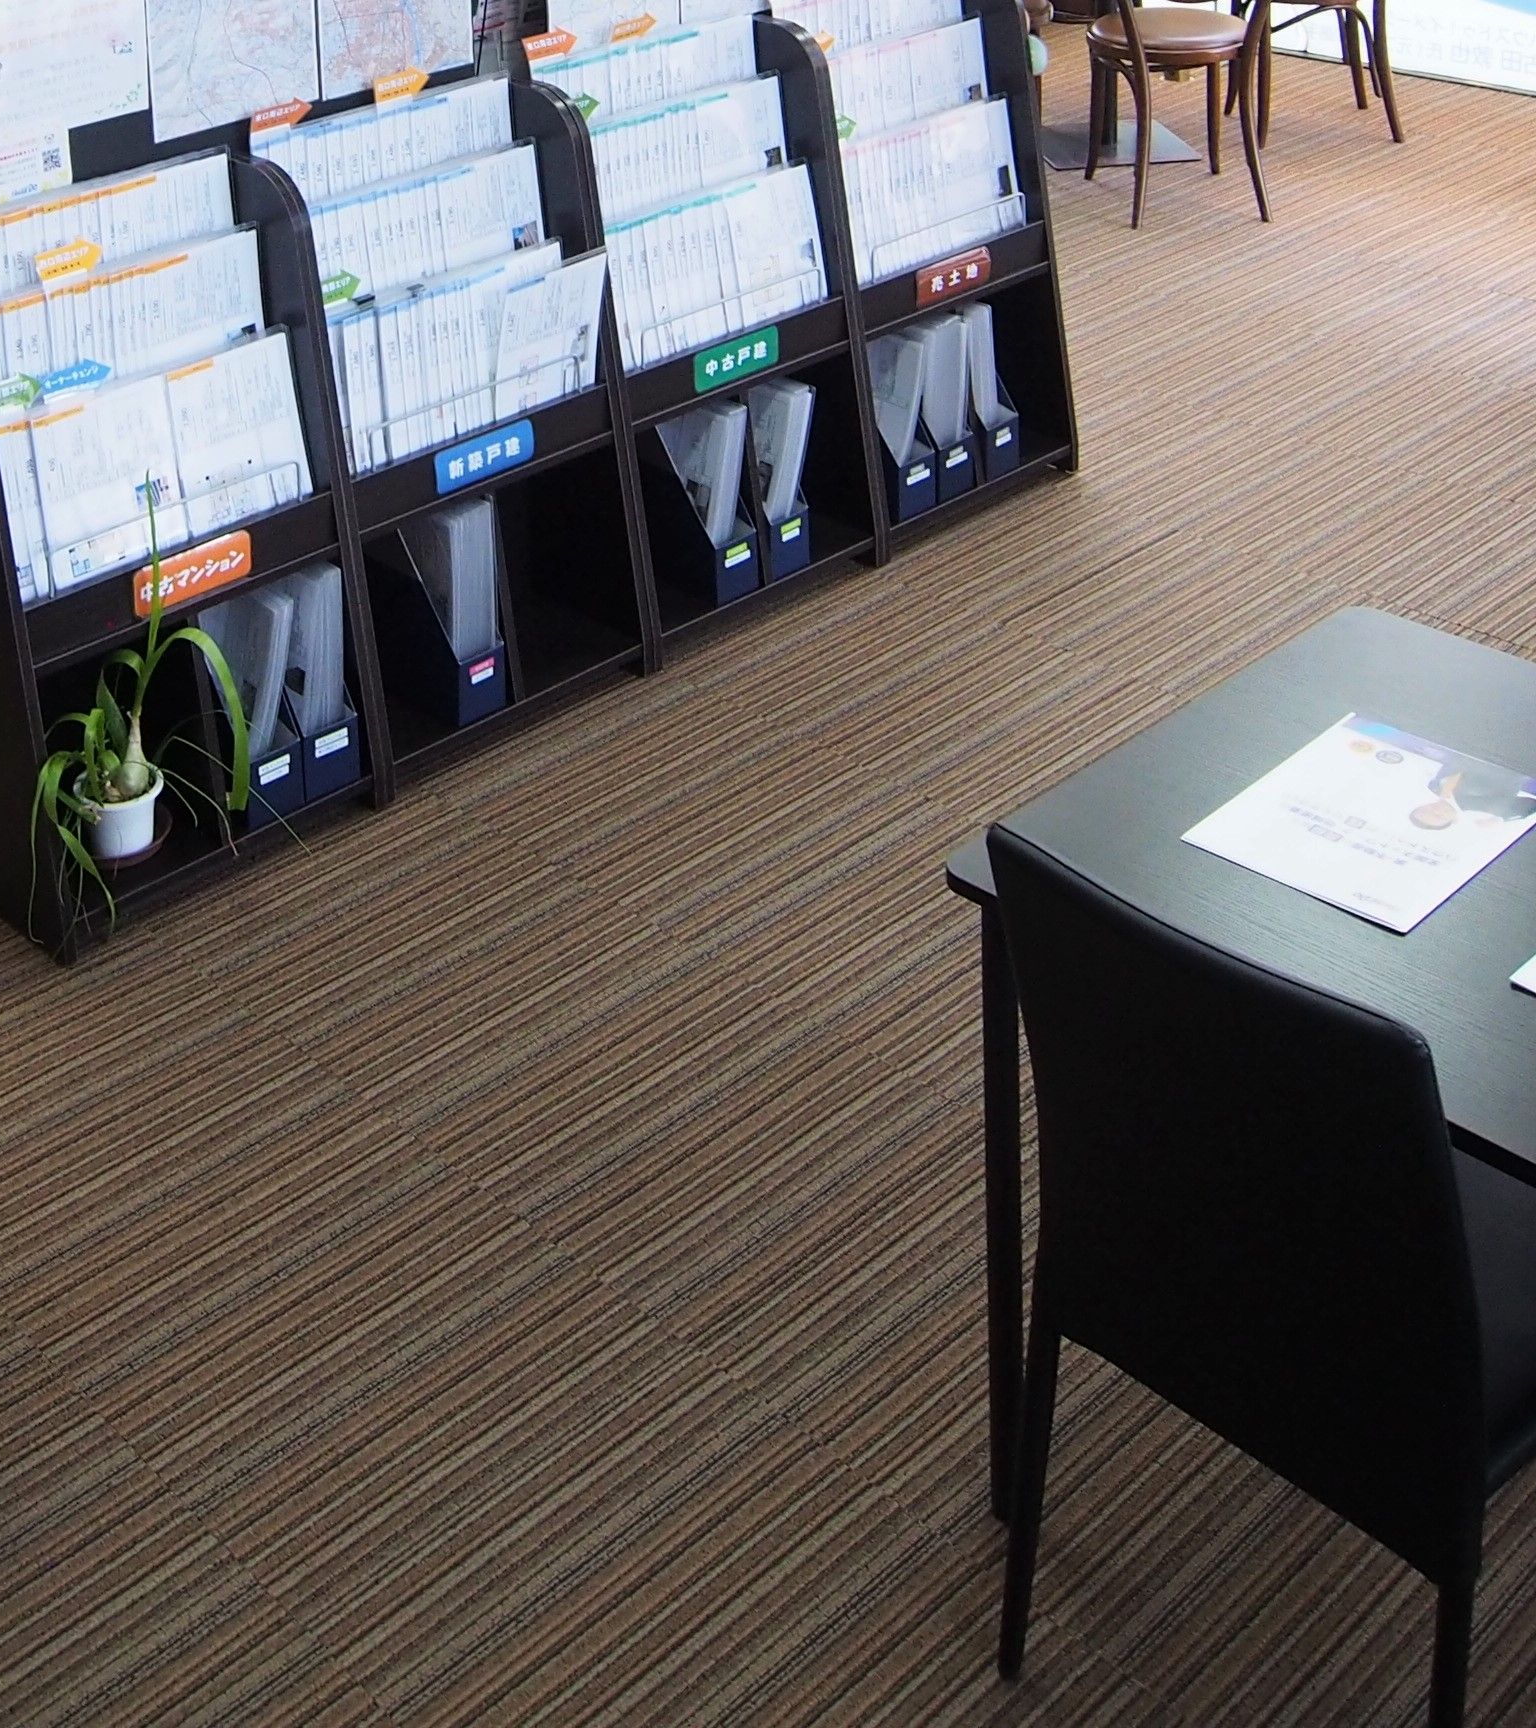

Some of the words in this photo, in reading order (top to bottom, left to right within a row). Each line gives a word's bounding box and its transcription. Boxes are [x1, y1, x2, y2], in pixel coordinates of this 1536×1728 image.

[930, 262, 979, 293] 売土地
[704, 340, 768, 377] 中古戸建
[448, 436, 521, 480] 新築戸建
[139, 549, 246, 603] 中古マンション
